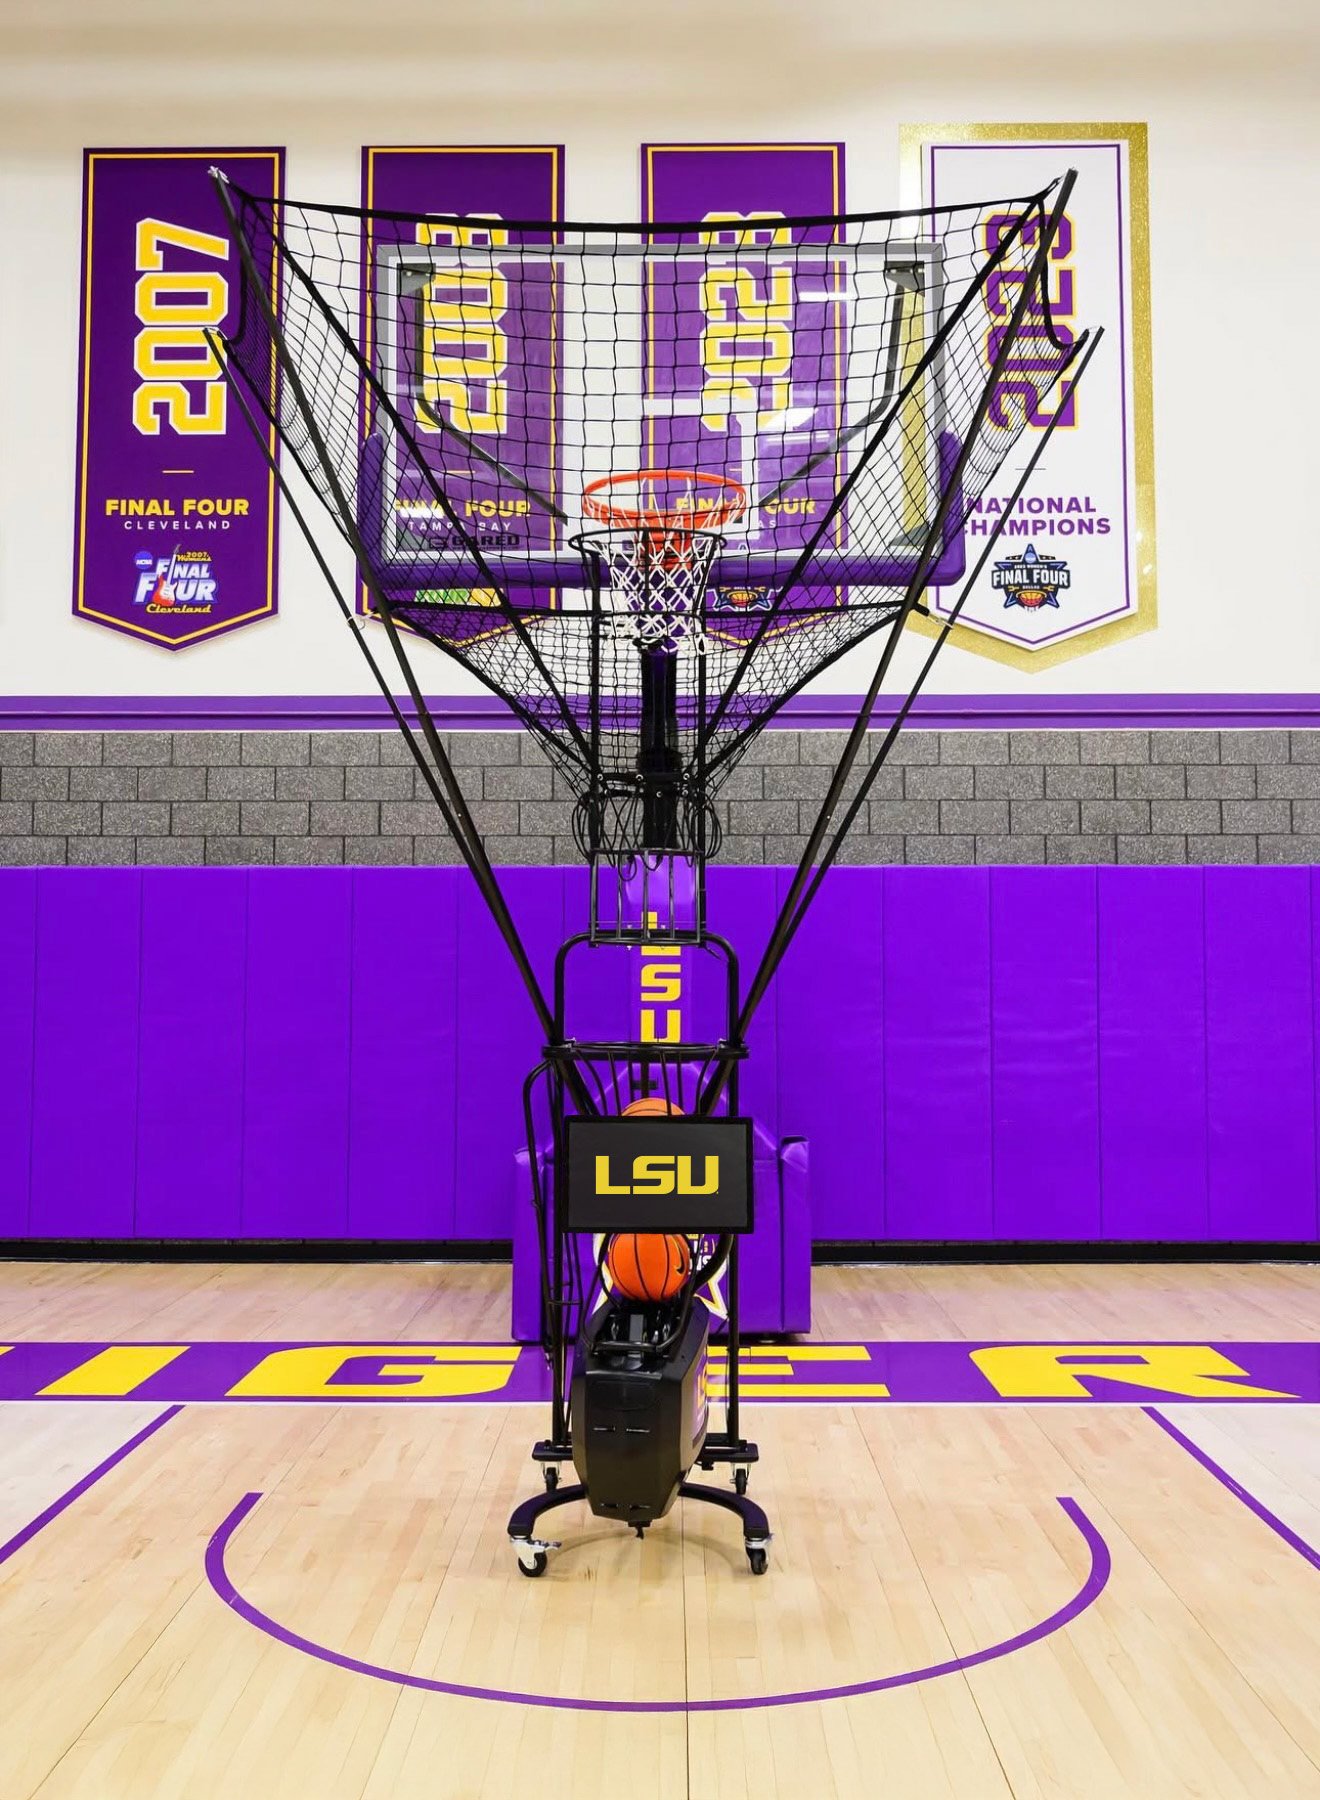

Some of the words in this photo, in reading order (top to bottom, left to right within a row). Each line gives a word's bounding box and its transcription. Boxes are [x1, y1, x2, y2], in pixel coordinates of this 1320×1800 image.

[133, 217, 229, 435] 2007
[982, 211, 1078, 430] 2023
[105, 499, 175, 516] FINAL
[183, 499, 249, 516] FOUR
[466, 499, 531, 517] FOUR
[763, 497, 816, 515] OUR
[124, 520, 231, 530] CLEVELAND
[478, 521, 511, 531] BAY
[964, 518, 1111, 536] HAMPIONS
[993, 569, 1030, 587] FINAL
[1033, 569, 1069, 587] FOUR
[146, 604, 212, 614] Cleveland
[595, 1155, 719, 1195] LSU
